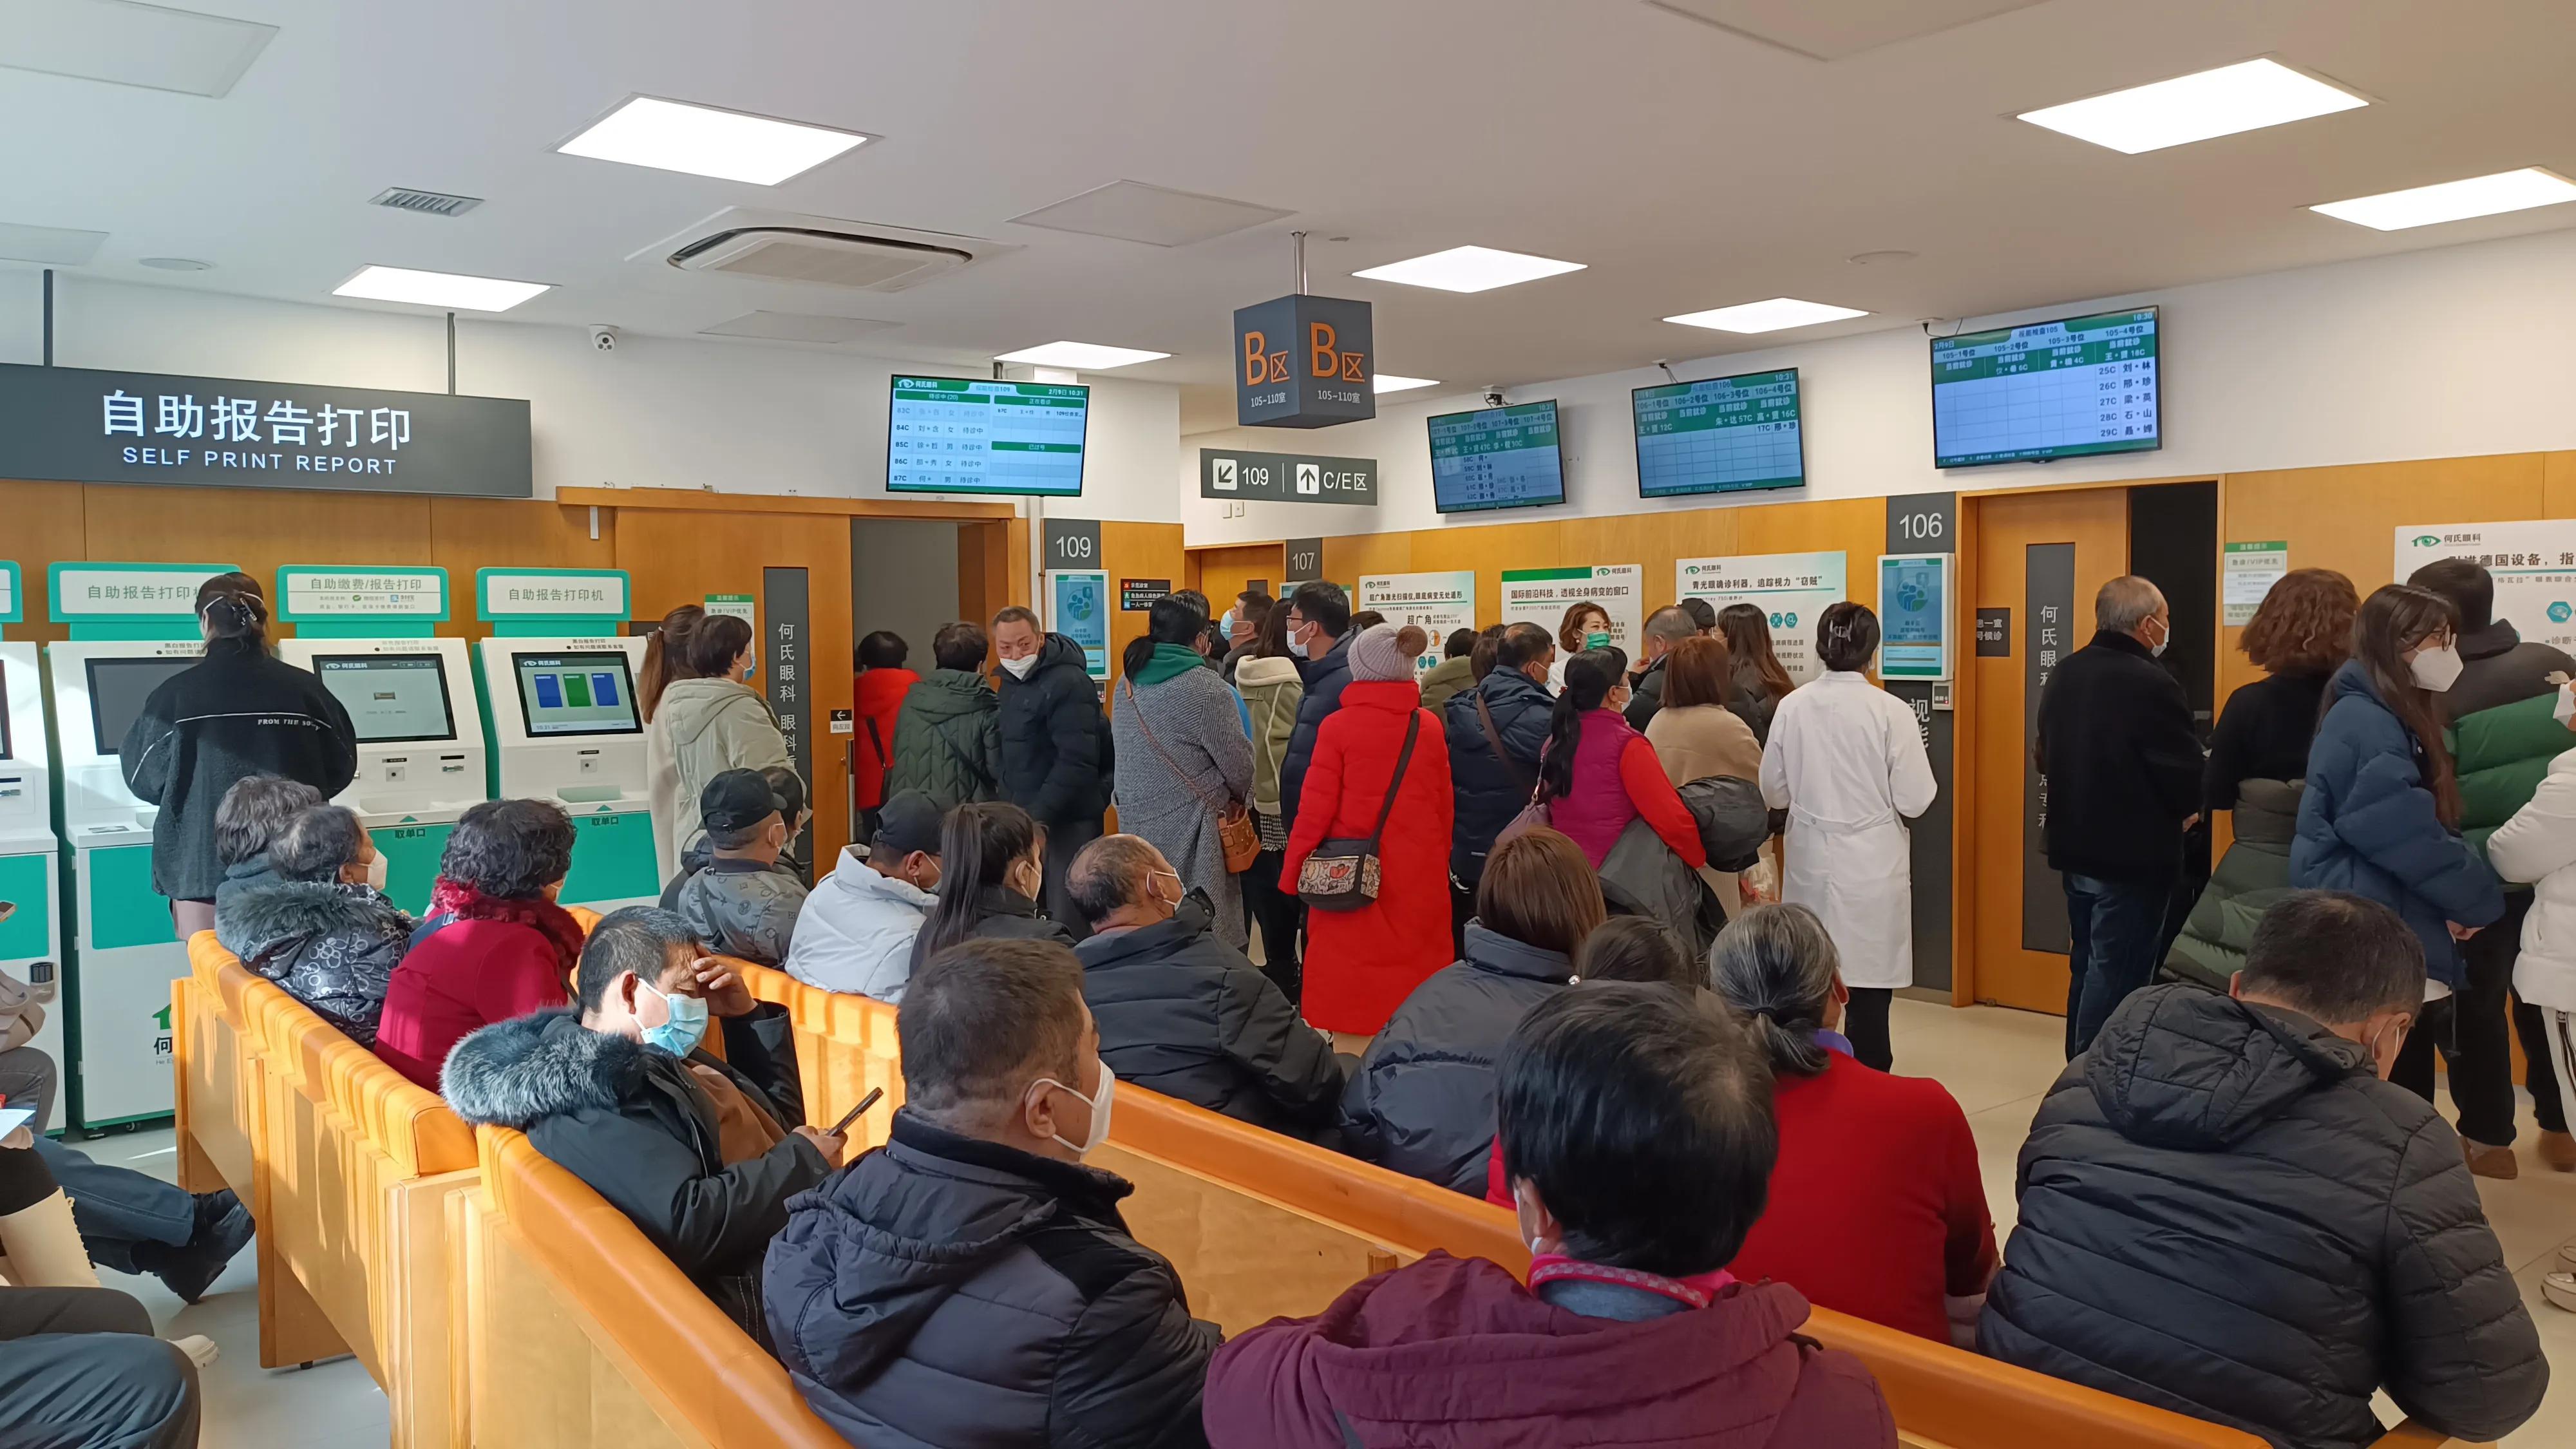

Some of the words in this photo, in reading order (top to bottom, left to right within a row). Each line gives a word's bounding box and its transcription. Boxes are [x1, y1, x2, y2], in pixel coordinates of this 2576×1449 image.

[2105, 325, 2144, 337] 105-4号位
[2049, 334, 2085, 345] 105-3号位
[1994, 341, 2029, 352] 105-2号位
[1311, 322, 1365, 383] B区
[1942, 349, 1975, 359] 105-1号位
[1245, 331, 1290, 386] B区
[2098, 365, 2116, 375] 25C
[1755, 383, 1792, 395] 106-4号位
[2099, 381, 2116, 391] 26C
[1674, 394, 1709, 405] 106-2号位
[1714, 389, 1750, 400] 106-3号位
[2099, 396, 2117, 406] 27C
[103, 389, 410, 450] 自助报告打印
[1738, 414, 1752, 422] 57C
[1781, 410, 1795, 418] 16C
[2100, 412, 2117, 422] 28C
[1757, 424, 1770, 432] 17C
[2101, 428, 2118, 438] 29C
[123, 447, 190, 465] SELF
[205, 451, 283, 469] PRINT
[296, 455, 396, 475] REPORT
[1242, 467, 1269, 486] 109
[1323, 471, 1367, 491] C/E区
[1899, 513, 1943, 539] 106
[2444, 533, 2481, 543] 何氏眼科
[1056, 536, 1092, 558] 109
[1293, 552, 1315, 571] 107
[311, 578, 422, 591] 自助缴费/报告打印
[509, 589, 603, 601] 自助报告打印机
[1407, 614, 1432, 625] 超广角
[779, 623, 796, 703] 何氏眼科
[591, 817, 620, 826] 取单口
[394, 829, 426, 839] 取单口
[154, 1036, 173, 1055] 何
